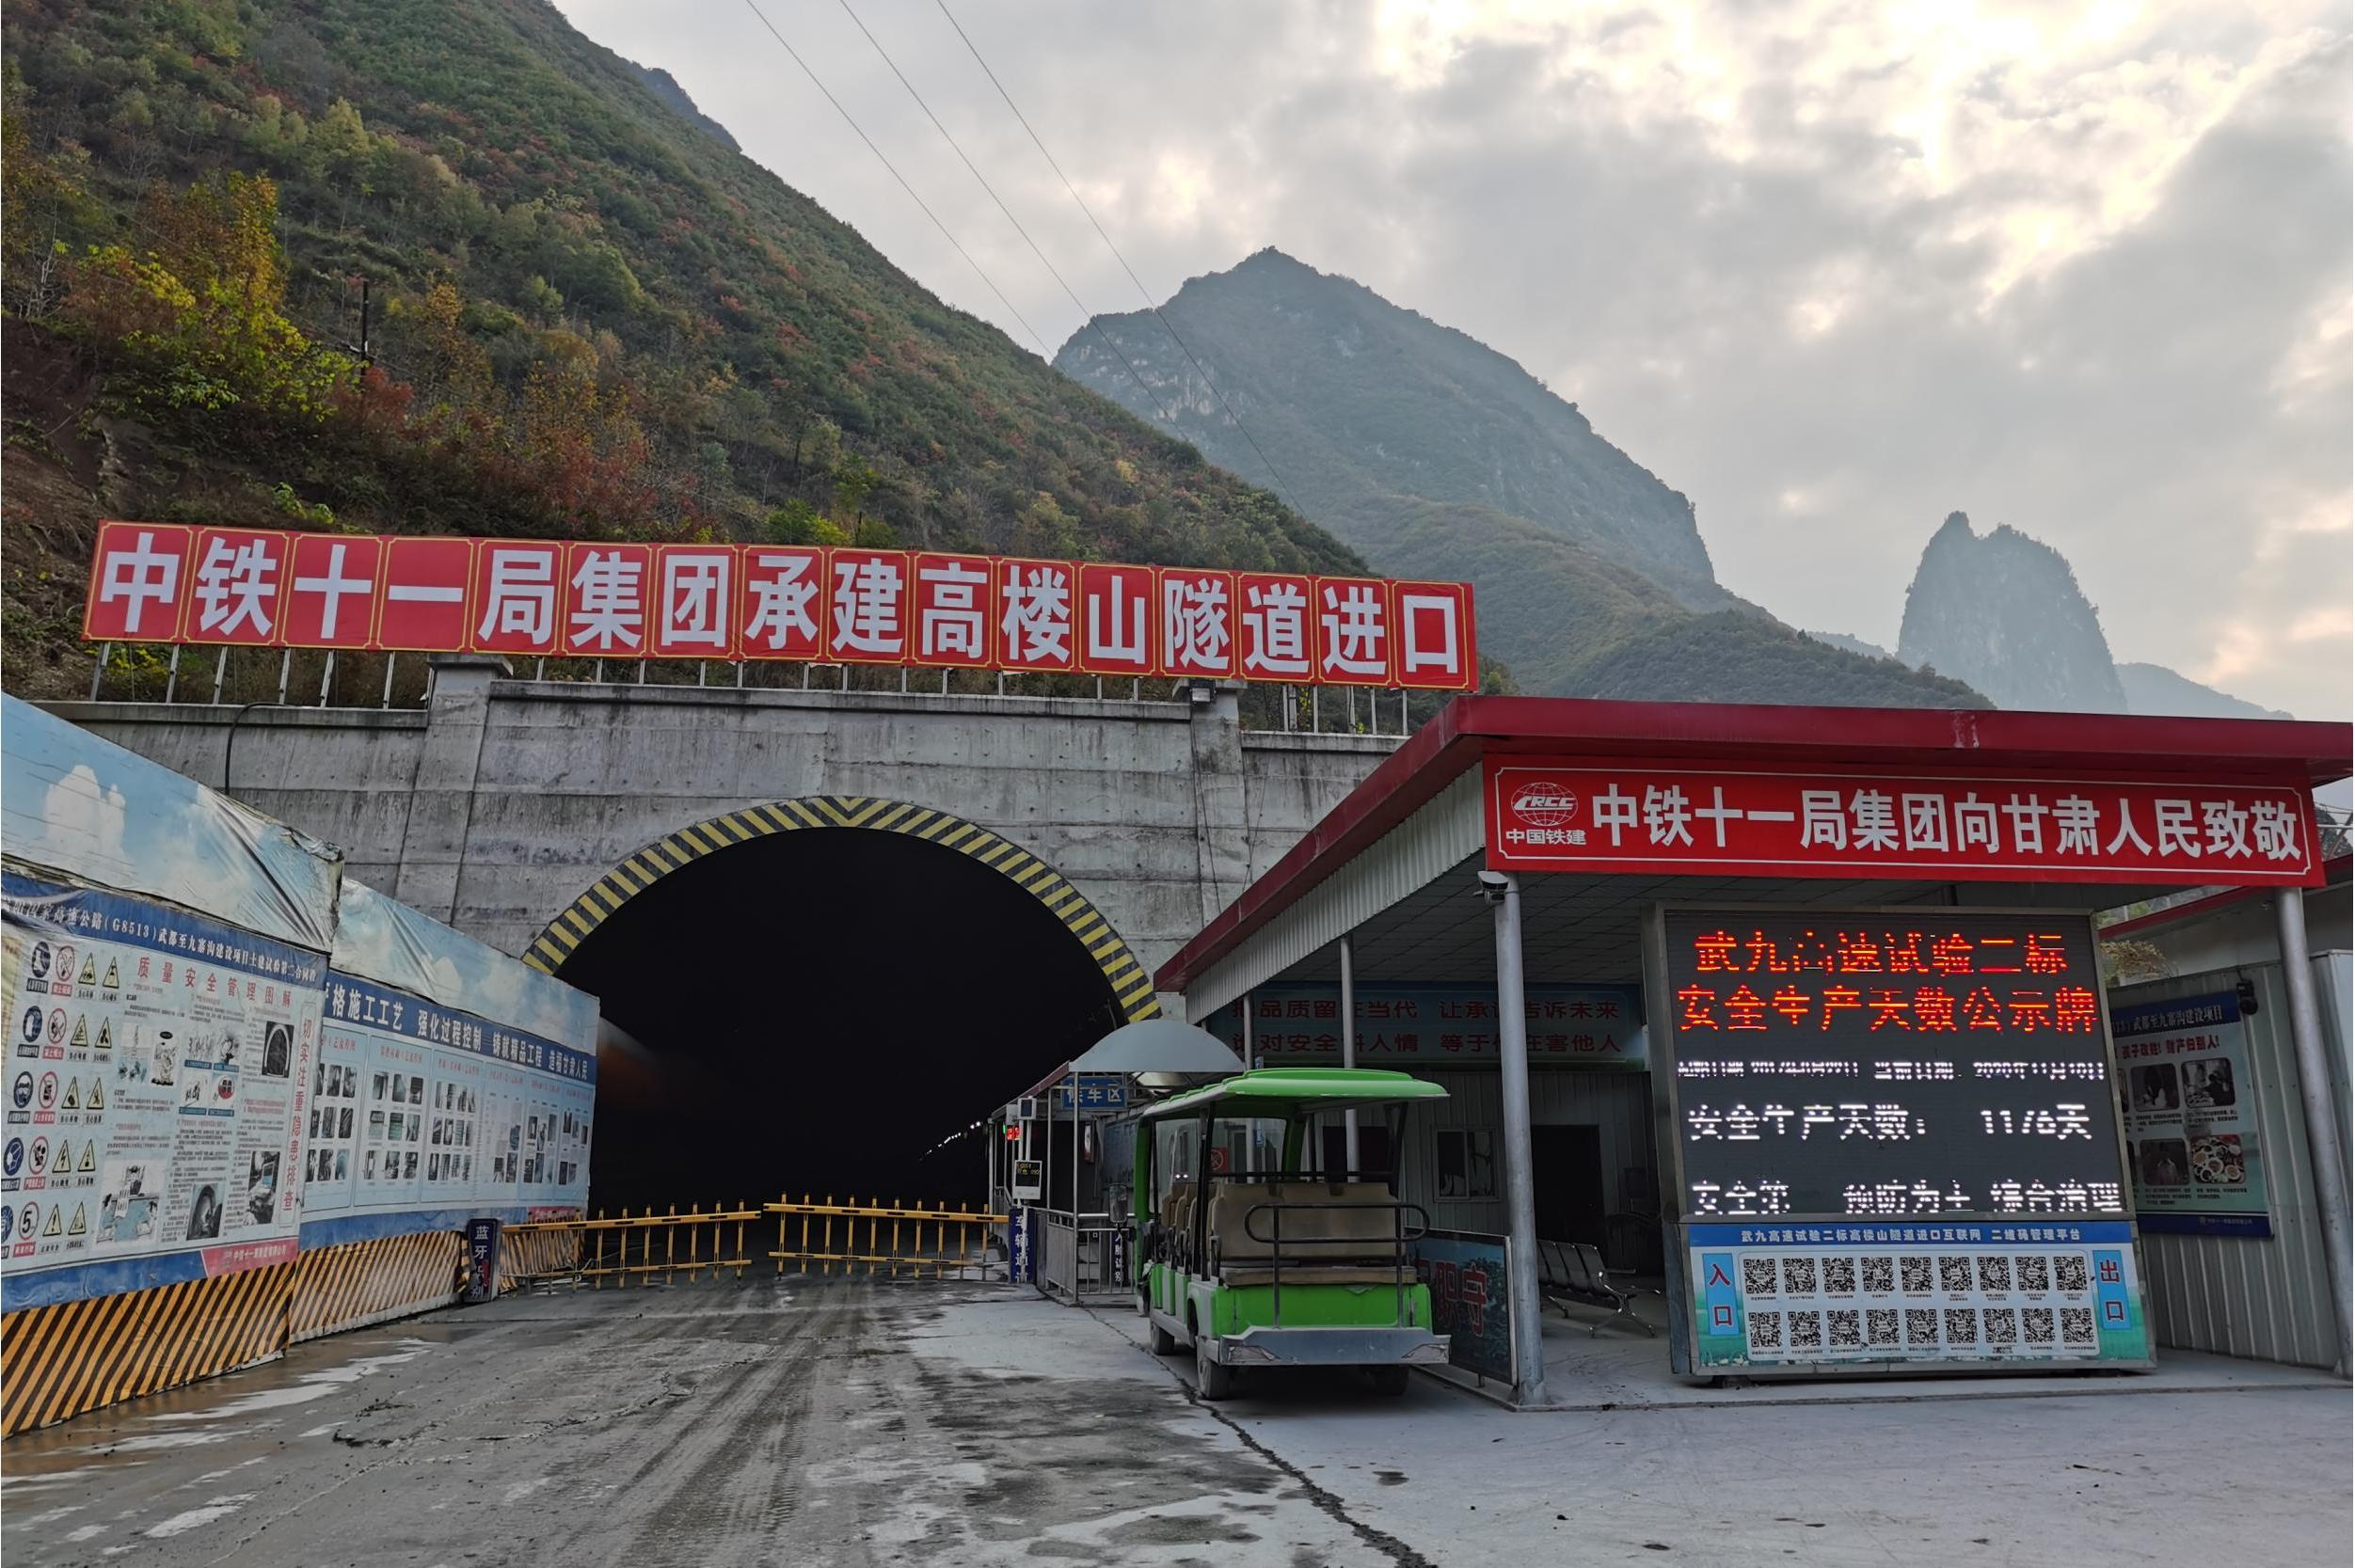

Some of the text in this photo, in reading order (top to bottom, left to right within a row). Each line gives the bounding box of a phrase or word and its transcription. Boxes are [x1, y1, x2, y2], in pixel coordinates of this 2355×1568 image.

[100, 531, 1459, 674] 中铁十一局集团承建高楼山隧道进口
[1513, 796, 1577, 811] CRCC
[1591, 783, 2301, 861] 中铁十一局集团向甘肃人民致敬
[1505, 829, 1586, 846] 中国铁建
[1695, 930, 2067, 976] 武九高速试验二标
[136, 956, 292, 1008] 质量安全管理图解
[326, 982, 403, 1031] 格施工工艺
[417, 1008, 483, 1053] 强化过程控制
[1678, 984, 2097, 1033] 安全生产天数公示牌
[1991, 1227, 2081, 1242] 二维码管理平台
[1709, 1263, 1734, 1326] 入口
[2099, 1259, 2124, 1322] 出口
